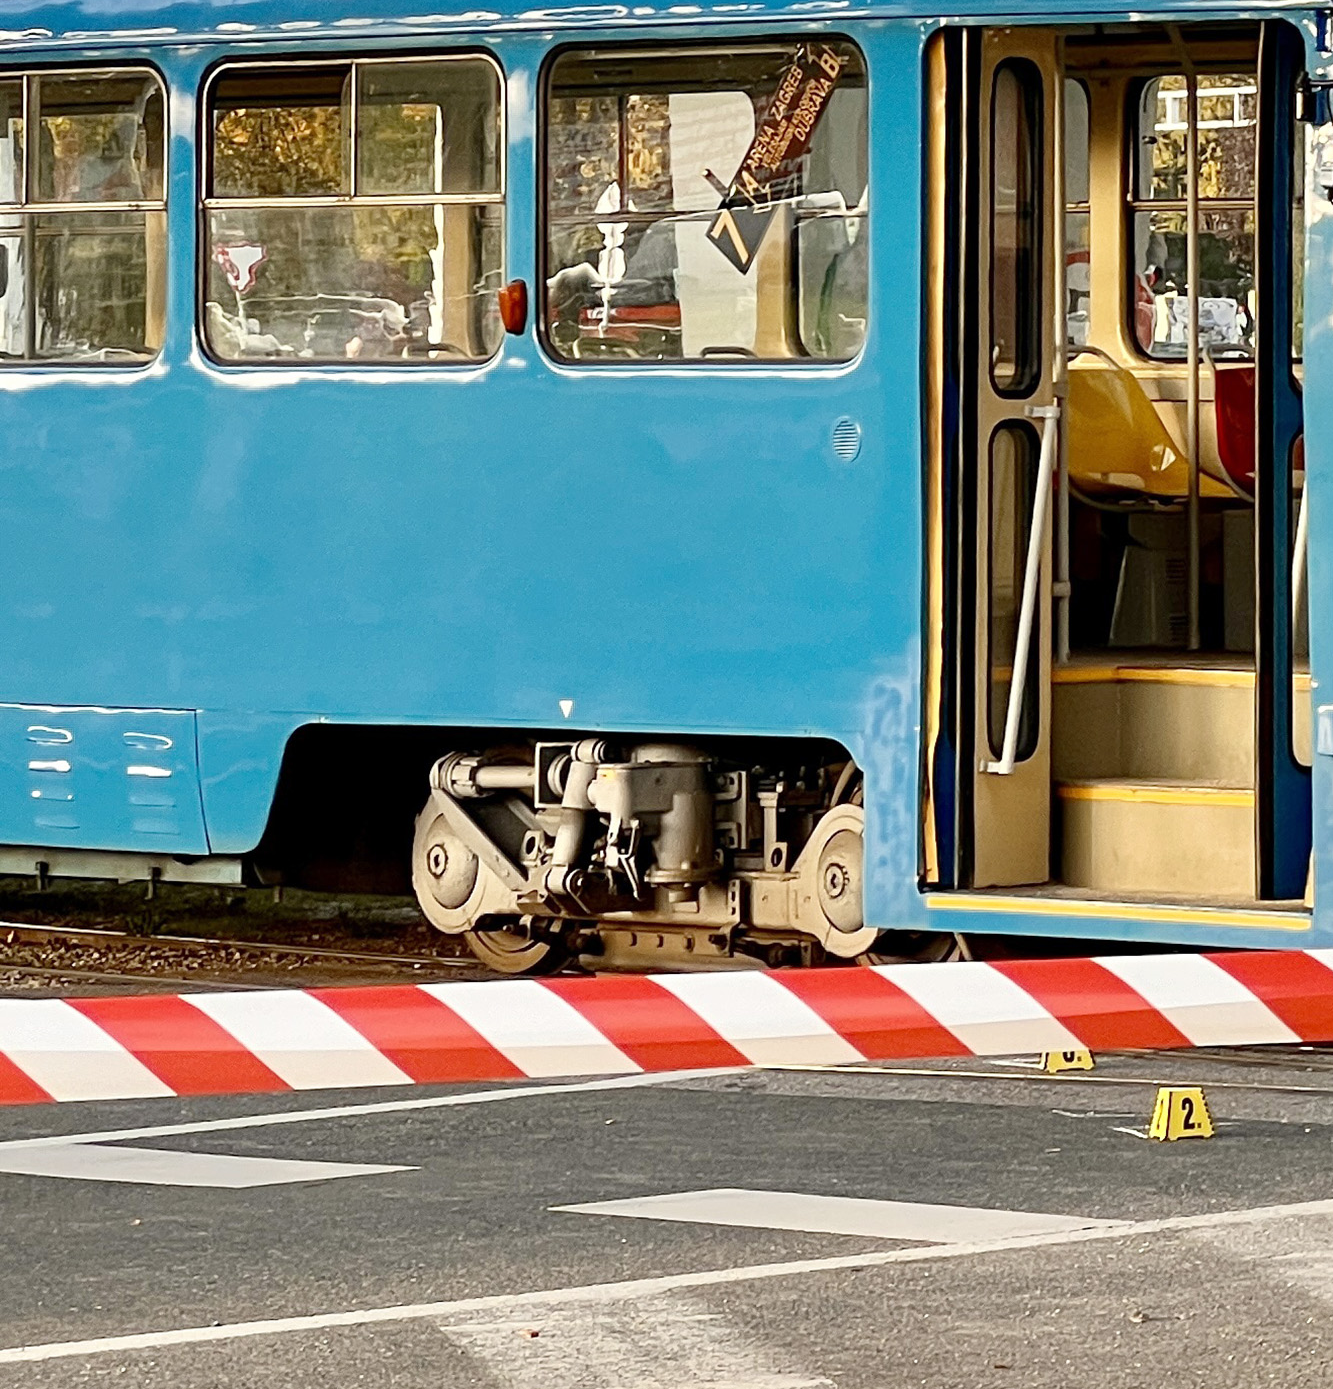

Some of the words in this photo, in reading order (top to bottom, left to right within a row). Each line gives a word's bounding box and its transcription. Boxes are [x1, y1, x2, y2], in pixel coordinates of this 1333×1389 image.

[746, 125, 775, 172] ARENA
[770, 65, 803, 121] ZAGREB
[794, 77, 832, 142] DUBRAVA
